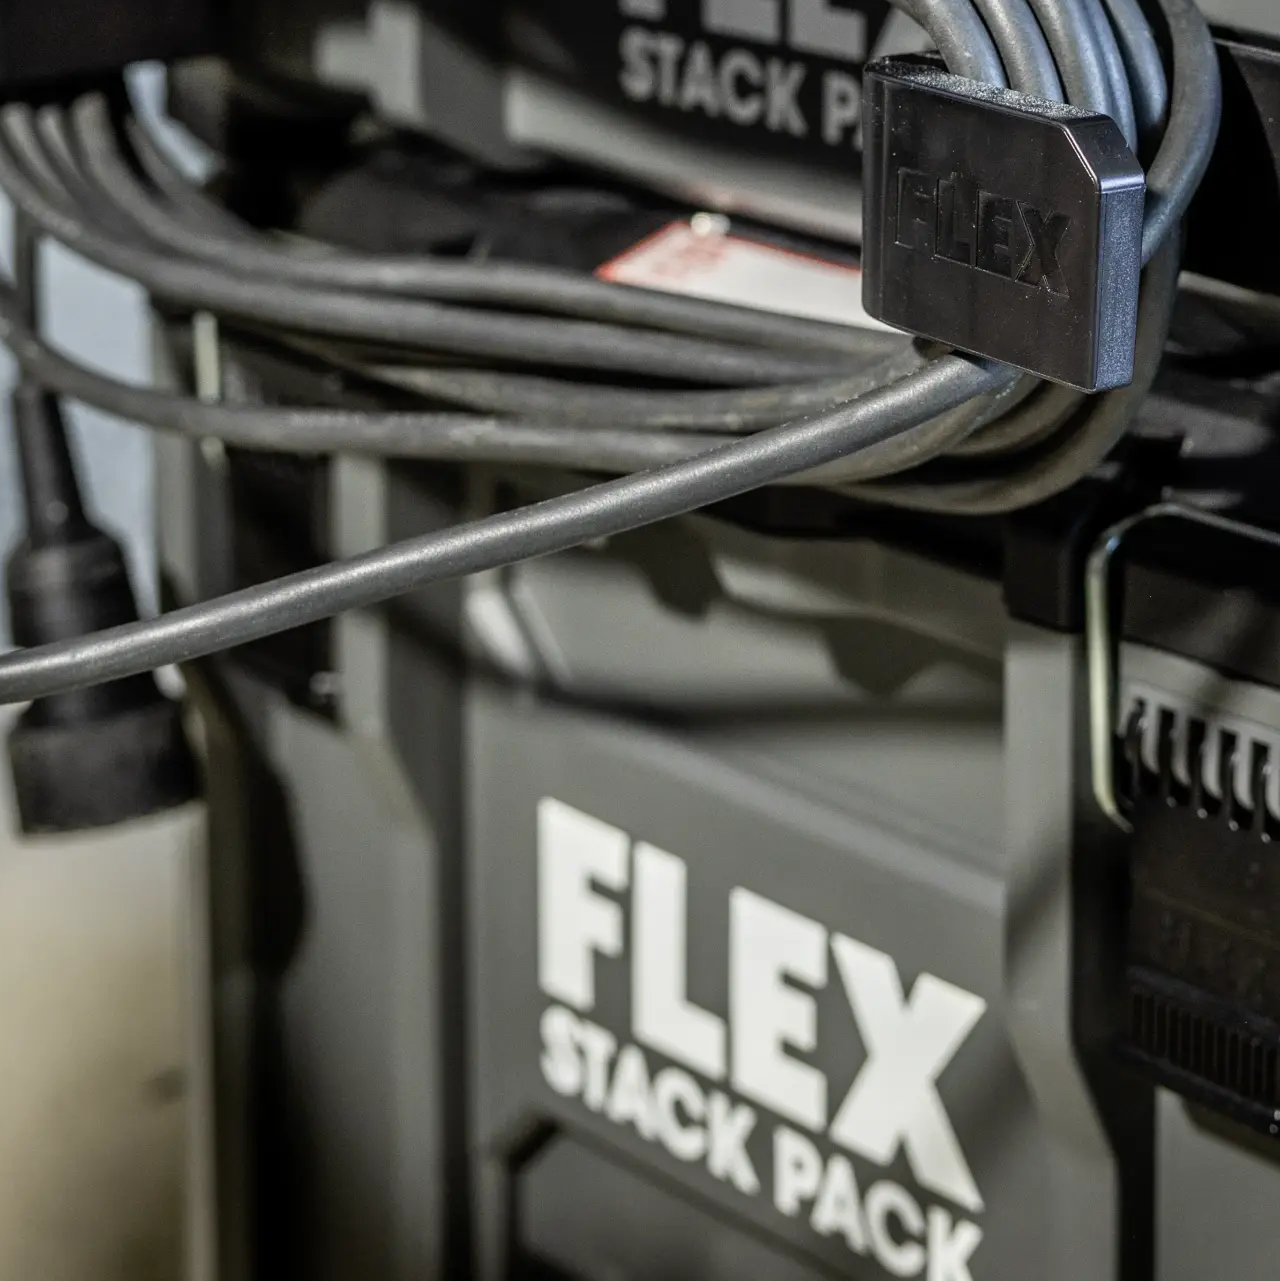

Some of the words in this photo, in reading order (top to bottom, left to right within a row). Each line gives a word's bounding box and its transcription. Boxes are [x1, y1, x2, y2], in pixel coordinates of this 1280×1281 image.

[618, 26, 809, 138] STACK
[894, 166, 1072, 298] FLEX
[536, 795, 988, 1214] FLEX
[539, 1003, 761, 1196] STACK
[771, 1124, 984, 1281] PACK
